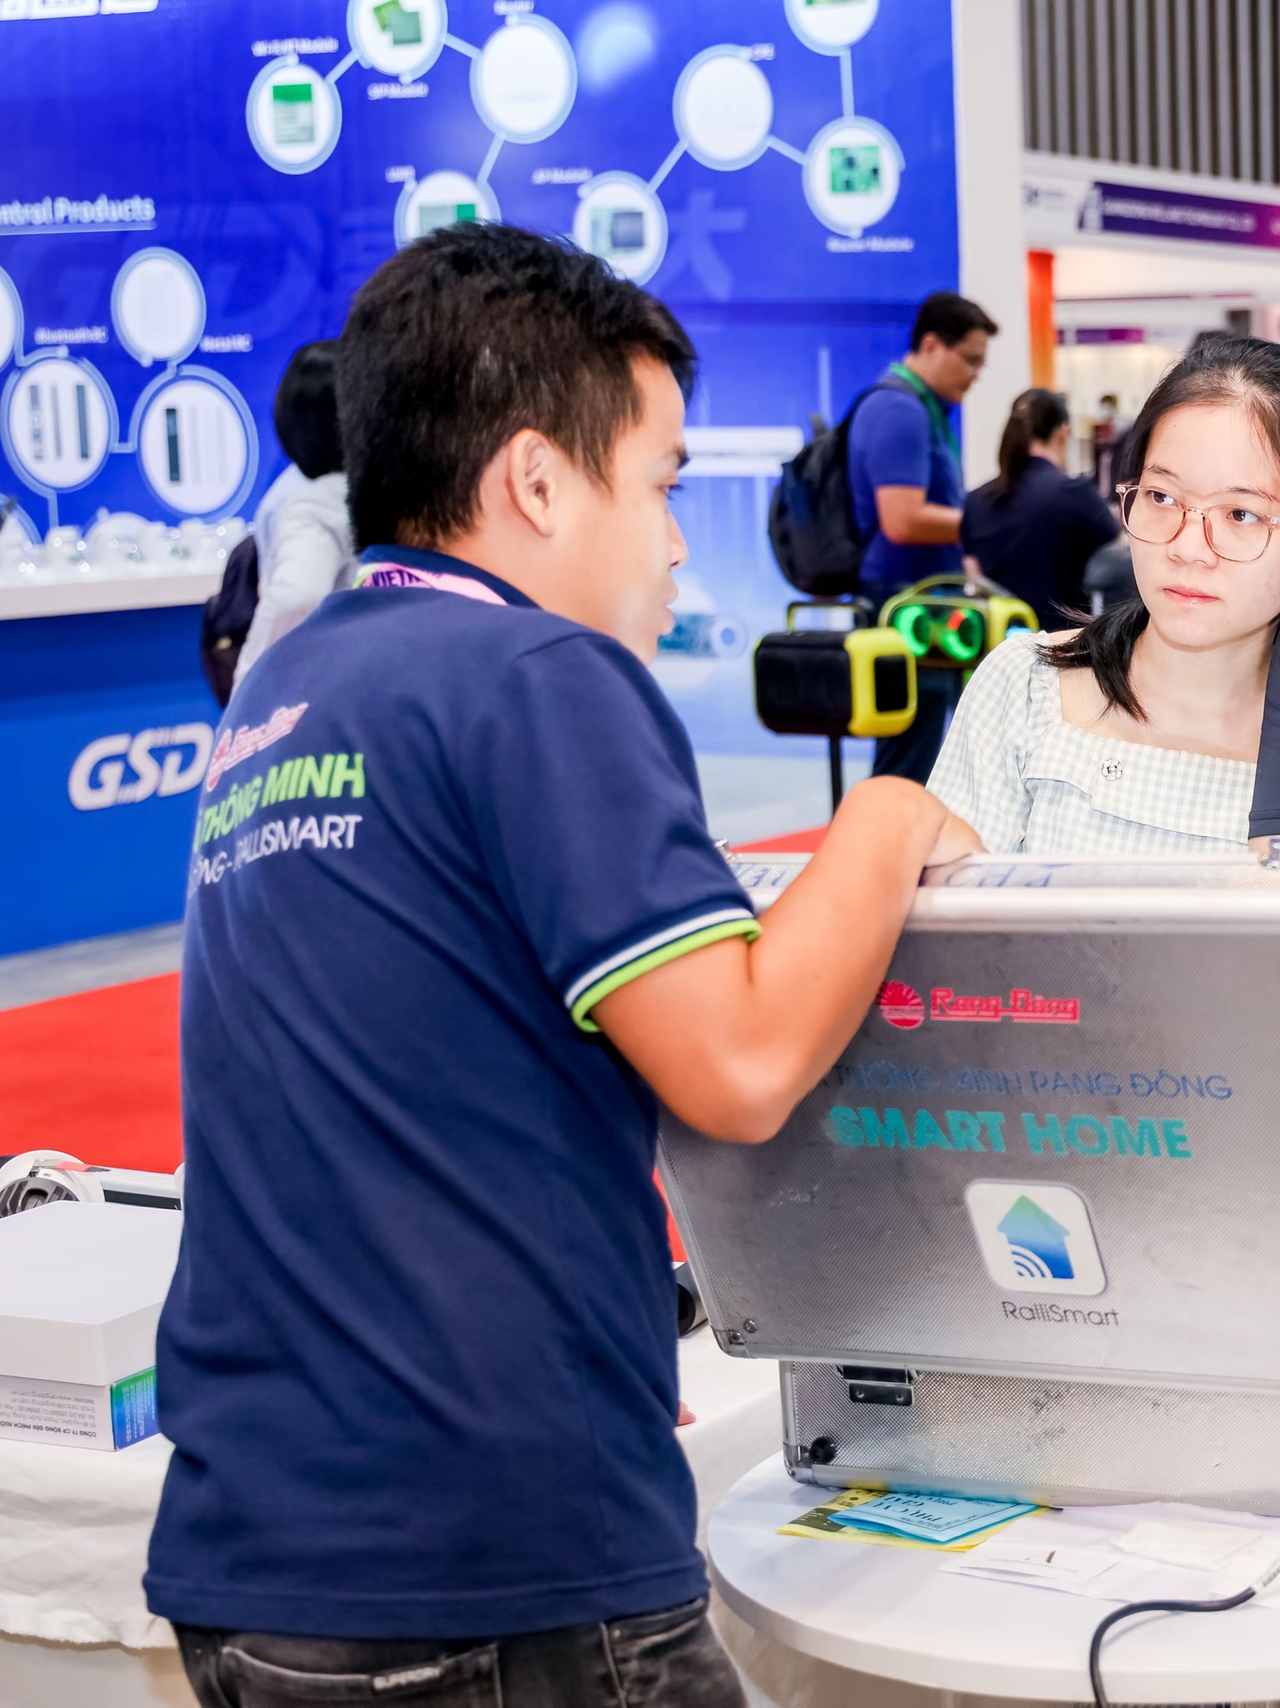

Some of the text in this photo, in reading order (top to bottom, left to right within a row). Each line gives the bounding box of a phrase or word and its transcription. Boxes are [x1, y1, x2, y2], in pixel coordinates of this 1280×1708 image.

[54, 193, 156, 224] Products
[68, 722, 214, 811] GSD
[261, 753, 366, 808] MINH
[1130, 1068, 1233, 1102] ĐÔNG
[829, 1105, 1193, 1160] SMART HOME
[1001, 1300, 1119, 1326] RalliSmart
